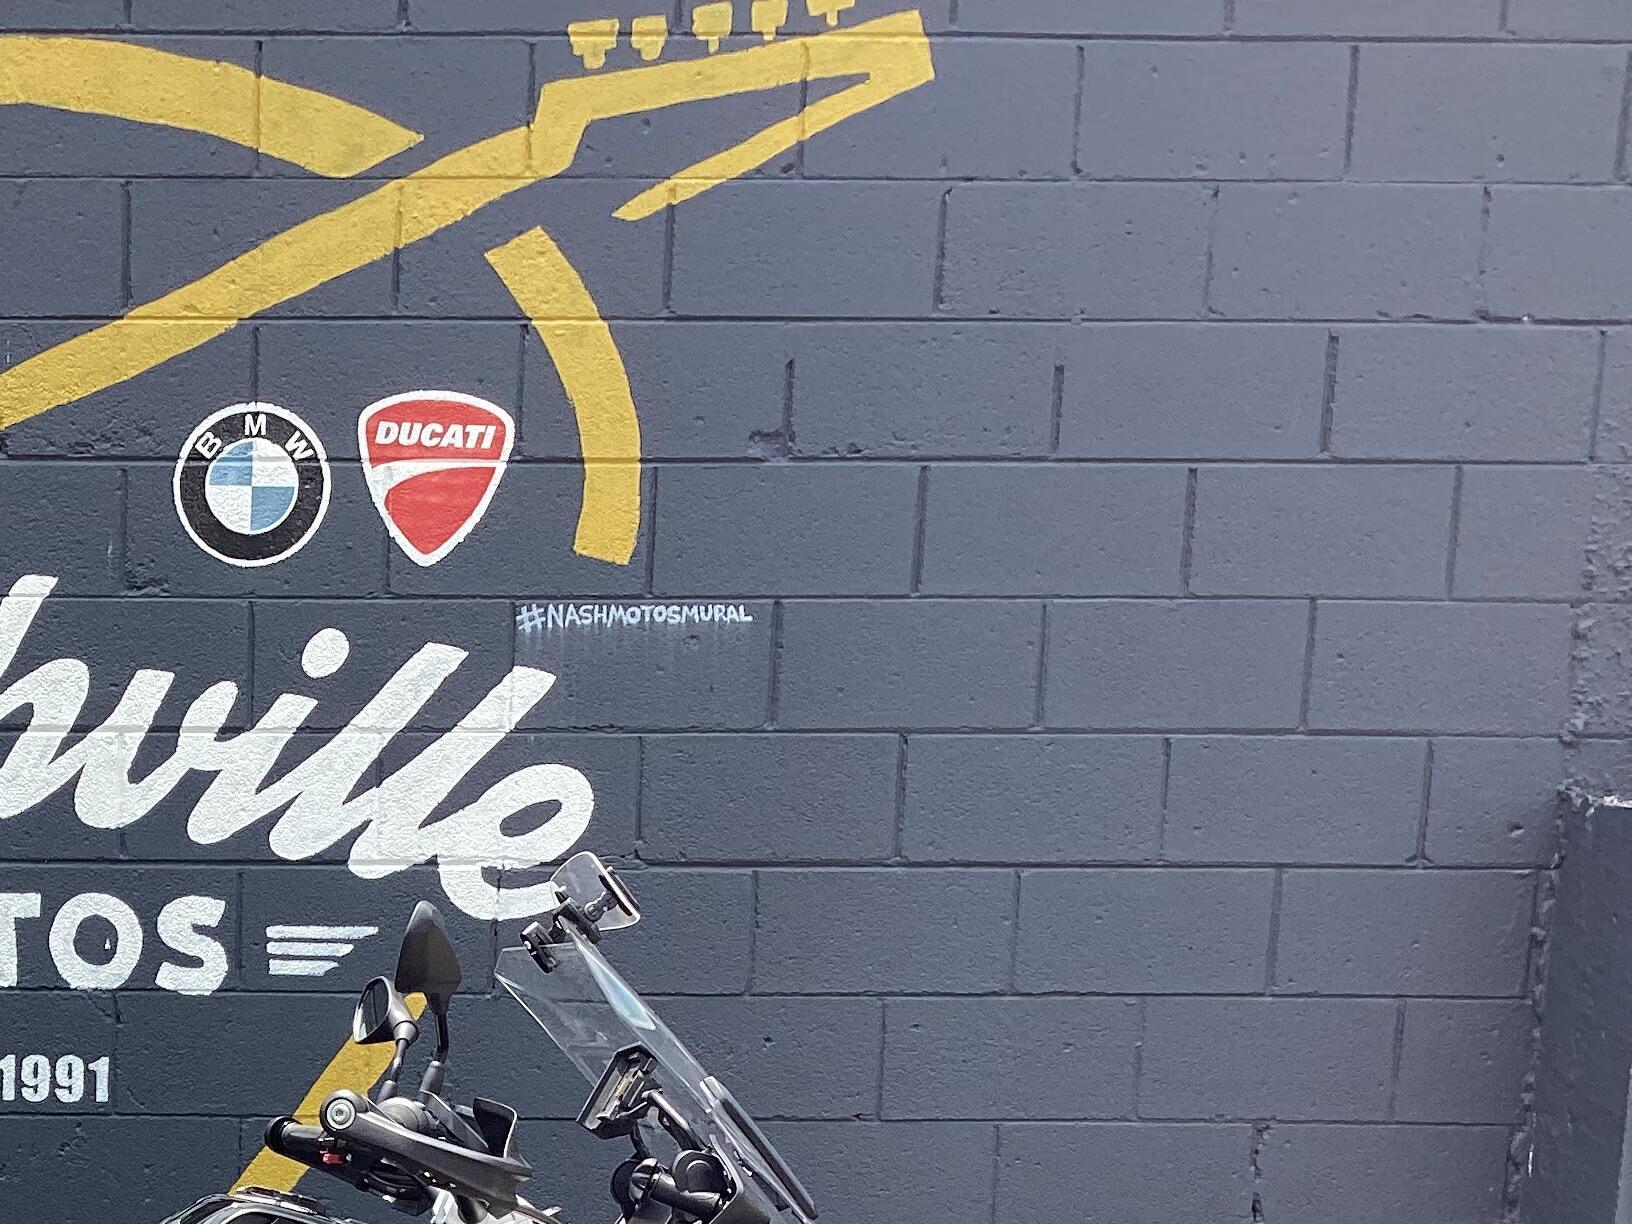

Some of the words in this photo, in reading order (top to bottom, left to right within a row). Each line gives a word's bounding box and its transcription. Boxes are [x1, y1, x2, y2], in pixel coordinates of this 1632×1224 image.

[195, 412, 314, 462] BMW
[374, 421, 497, 451] DUCATI
[514, 603, 754, 633] #NASHMOTOSMURAL
